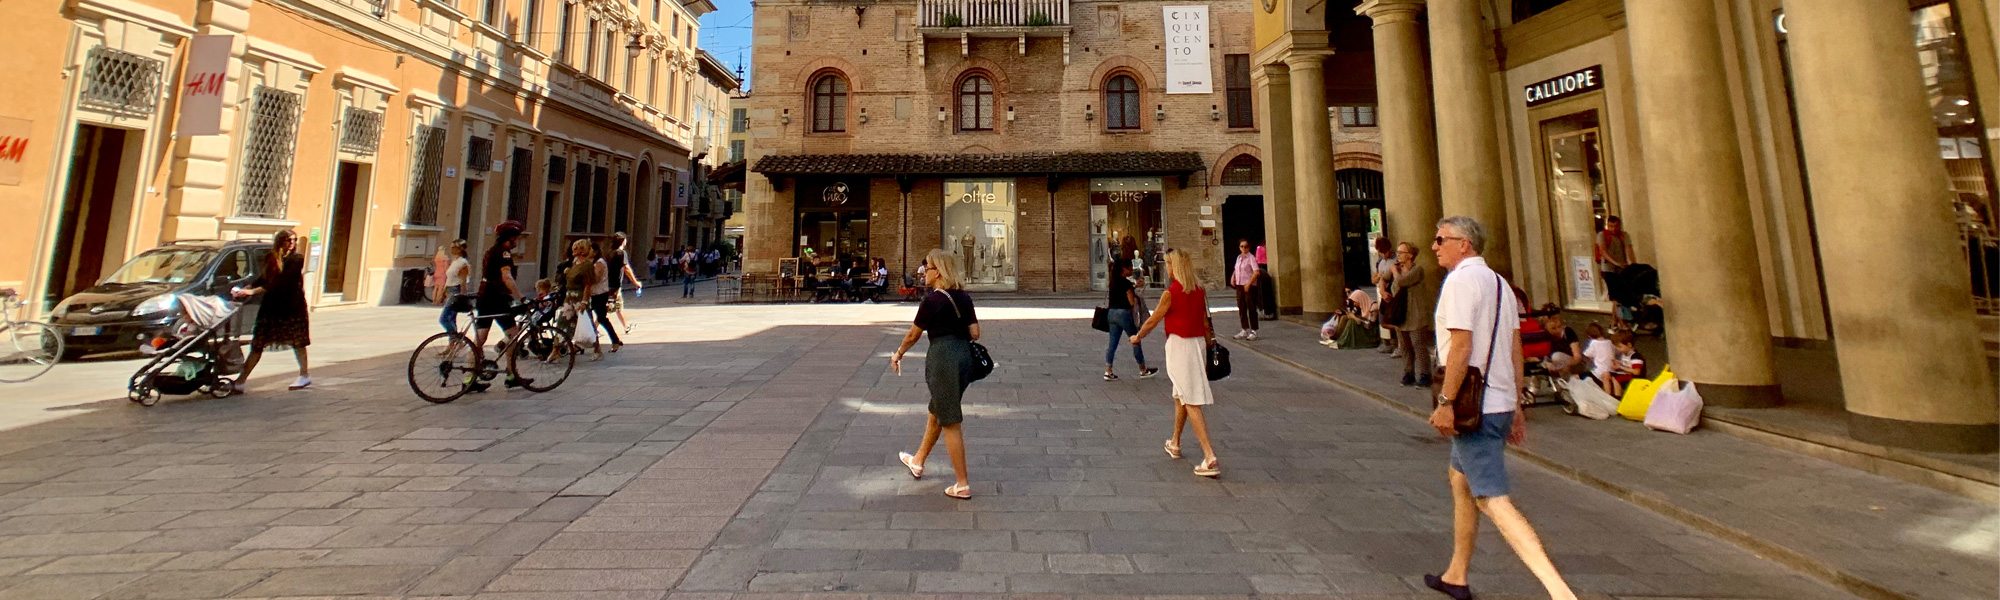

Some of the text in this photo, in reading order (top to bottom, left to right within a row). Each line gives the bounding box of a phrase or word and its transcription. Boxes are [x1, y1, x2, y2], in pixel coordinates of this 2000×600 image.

[185, 72, 225, 96] H&M
[1525, 69, 1595, 103] CALLIOPE
[962, 190, 996, 204] oltre
[1109, 190, 1144, 203] oltre
